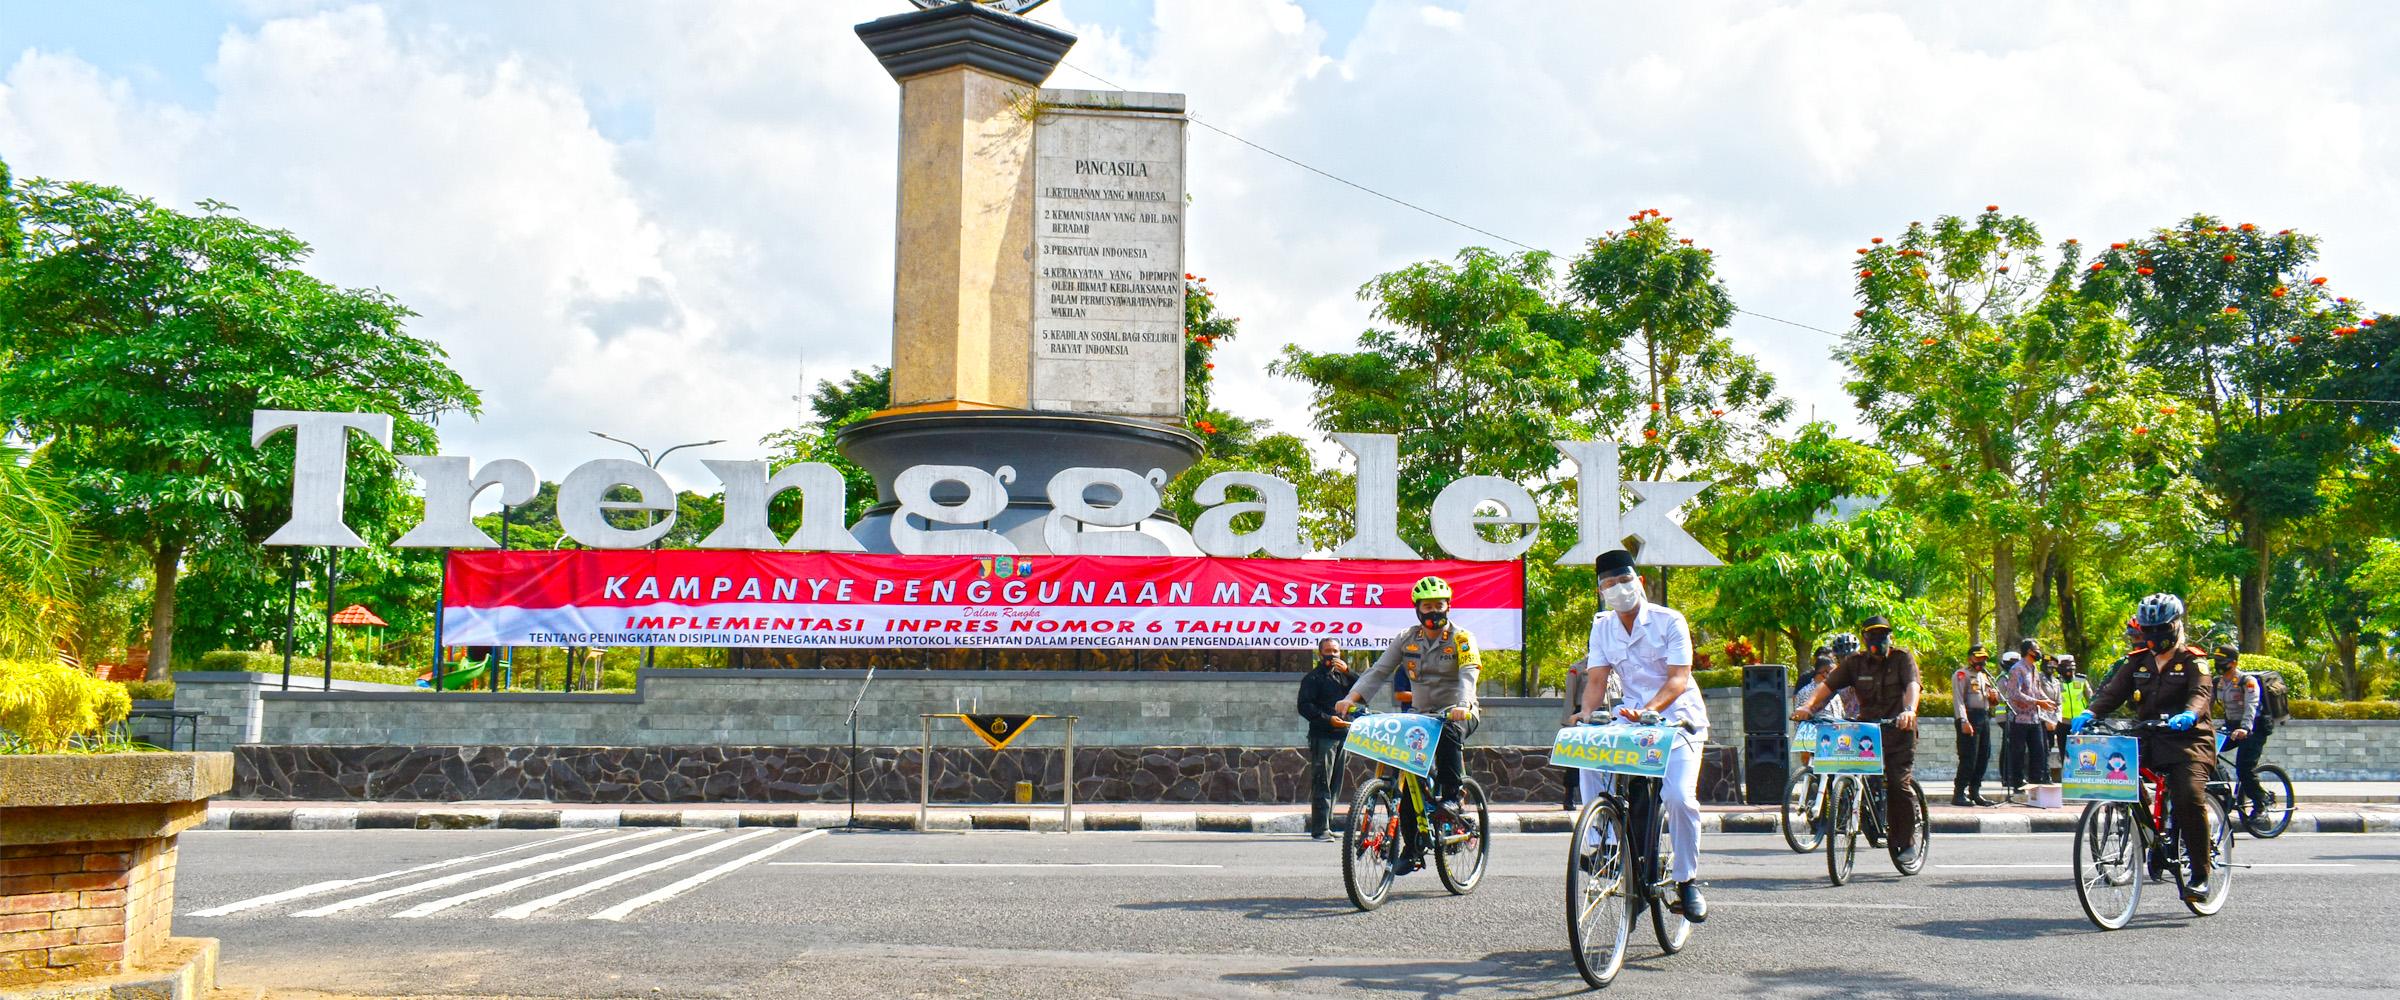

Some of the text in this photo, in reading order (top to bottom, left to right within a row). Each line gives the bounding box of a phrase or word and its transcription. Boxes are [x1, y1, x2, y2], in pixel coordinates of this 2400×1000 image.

[1075, 160, 1147, 177] PANCASILA
[1052, 188, 1100, 199] KETUHANAN
[1103, 190, 1124, 200] YANG
[1127, 191, 1166, 201] MAHAESA
[1052, 210, 1110, 221] KEMANUSIAAN
[1113, 212, 1135, 222] YANG
[1139, 213, 1159, 223] ADIL
[1162, 214, 1179, 224] DAN
[1052, 223, 1090, 234] BERADAB
[1052, 245, 1099, 257] PERSATUAN
[1102, 247, 1148, 258] INDONESIA
[1051, 268, 1103, 278] KERAKYATAN
[1109, 270, 1132, 280] YANG
[1140, 271, 1178, 281] DIPIMPIN
[1052, 281, 1177, 294] OLEH HIKMAT KEBIJAKSANAAN
[1051, 294, 1078, 304] DALAM
[1051, 307, 1086, 317] WAKILAN
[1050, 330, 1089, 340] KEADILAN
[1091, 331, 1120, 341] SOSIAL
[1122, 332, 1141, 342] BAGI
[1142, 332, 1177, 343] SELURUH
[1050, 343, 1129, 355] RAKYAT INDONESIA
[253, 409, 1725, 566] Trenggalek
[603, 576, 1384, 606] KAMPANYE PENGGUNAAN MASKER
[963, 607, 1041, 619] Dalam Rangka
[625, 616, 1363, 634] IMPLEMENTASI INPRES NOMOR 6 TAHUN 2020
[529, 633, 586, 643] TENTANG
[590, 632, 676, 644] PENINGKATAN
[679, 633, 731, 644] DISIPLIN
[734, 633, 759, 644] DAN
[763, 634, 836, 645] PENEGAKAN
[840, 634, 884, 645] HUKUM
[888, 635, 951, 646] PROTOKOL
[955, 635, 1022, 646] KESEHATAN
[1026, 635, 1067, 646] DALAM
[1071, 636, 1150, 647] PENCEGAHAN
[1153, 636, 1177, 647] DAN
[1181, 636, 1270, 647] PENGENDALIAN
[1274, 637, 1319, 647] COVID-1
[1347, 637, 1372, 647] KAB.
[1351, 722, 1397, 746] PAKAI
[1557, 731, 1619, 748] PAKAI
[1347, 733, 1410, 763] MASKER
[1554, 743, 1640, 765] MASKER
